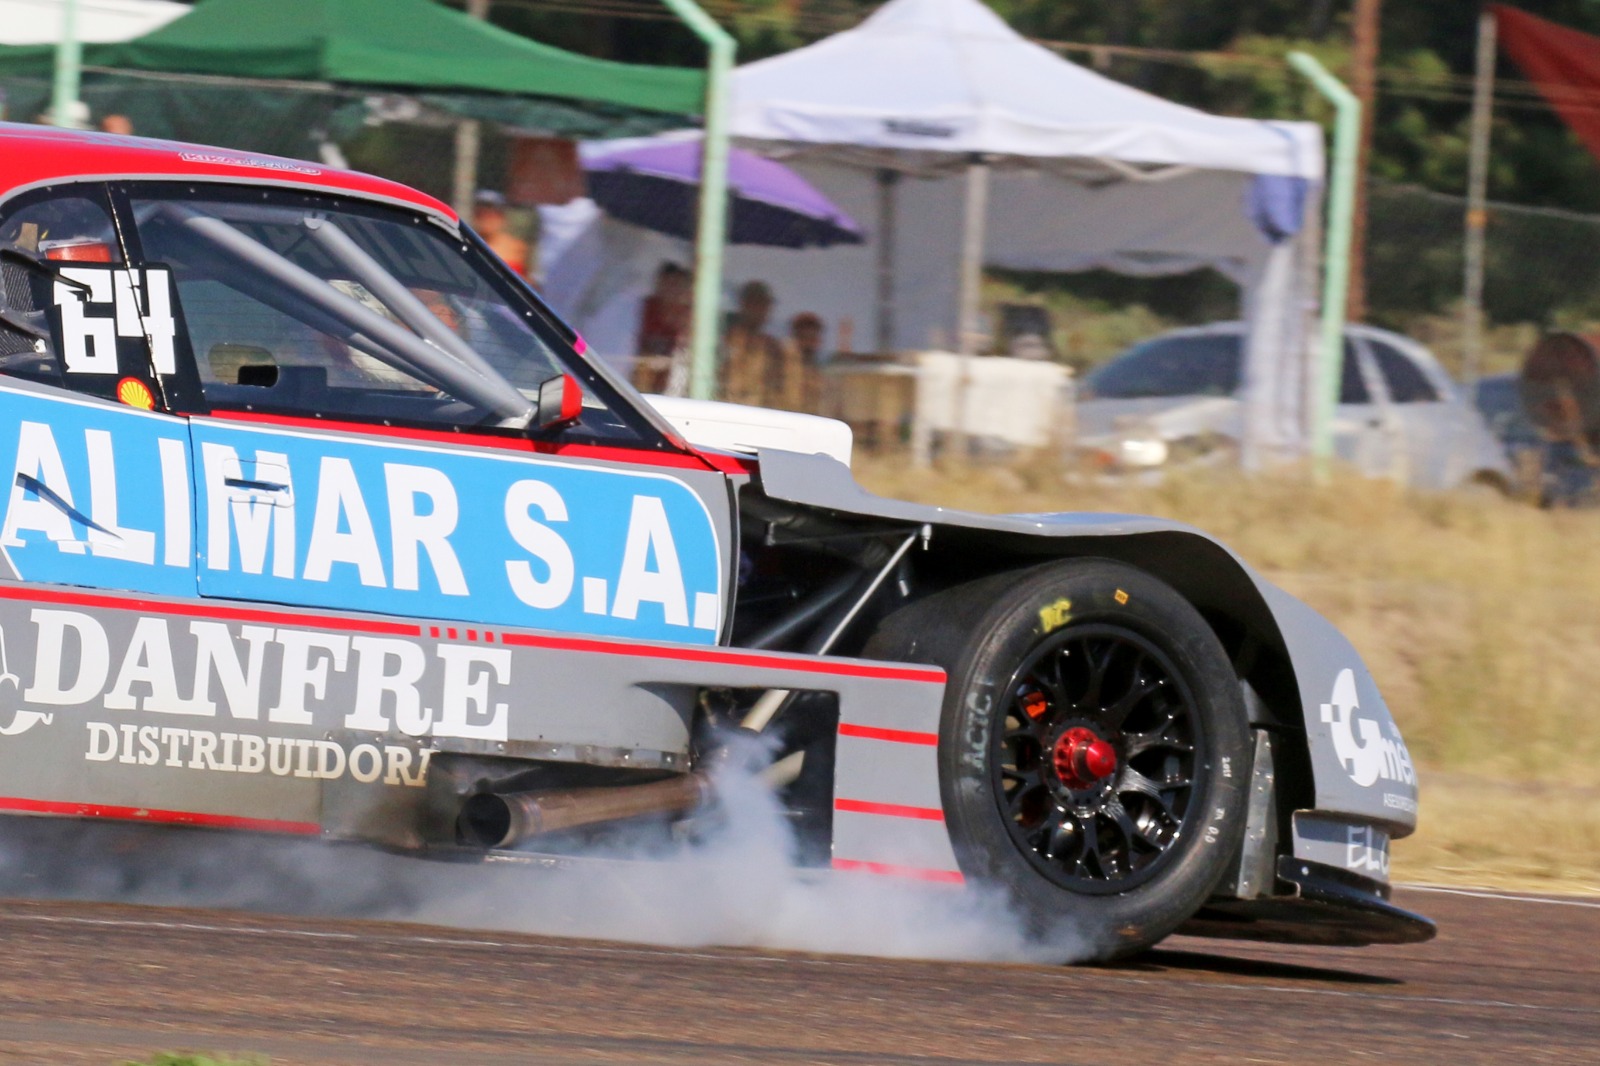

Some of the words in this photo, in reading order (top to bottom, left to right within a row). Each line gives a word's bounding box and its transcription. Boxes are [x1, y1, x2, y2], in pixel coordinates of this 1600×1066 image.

[54, 268, 176, 376] 64
[2, 420, 470, 596] ALIMAR
[504, 479, 717, 630] S.A.
[24, 608, 512, 742] DANFRE
